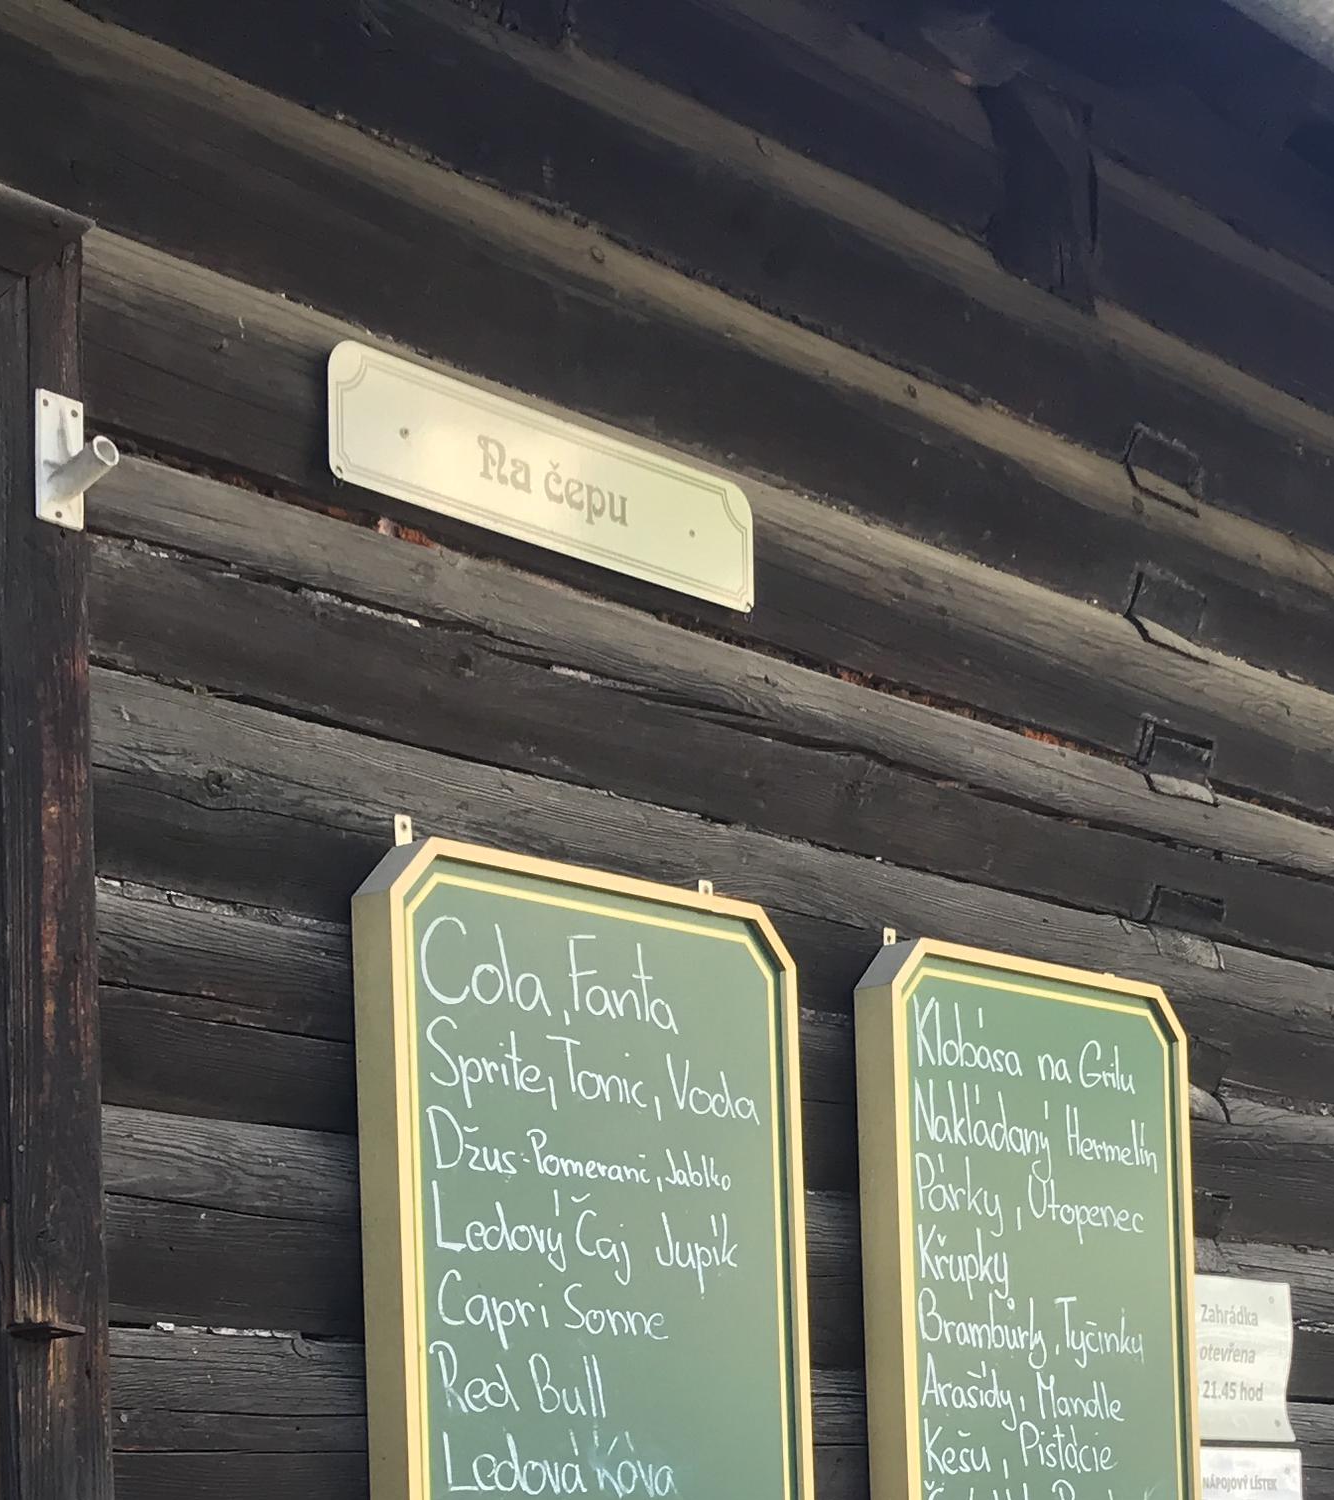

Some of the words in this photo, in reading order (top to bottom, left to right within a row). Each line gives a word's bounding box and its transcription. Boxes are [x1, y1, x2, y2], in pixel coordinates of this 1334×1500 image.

[477, 434, 533, 495] Na
[544, 459, 629, 527] čepu
[567, 934, 680, 1036] Fanta
[912, 993, 1023, 1078] Klobása
[1037, 1053, 1072, 1084] na
[1078, 1039, 1136, 1095] Grilu
[665, 1053, 761, 1126] Voda
[913, 1076, 1053, 1184] Nakládaný
[1066, 1103, 1159, 1174] Hermelín
[663, 1147, 733, 1193] Jablko
[432, 1180, 567, 1272] Ledový
[570, 1192, 632, 1285] Čaj
[655, 1211, 739, 1295] Jupík
[1027, 1173, 1145, 1245] Utopenec
[917, 1223, 1010, 1301] Křupky
[437, 1269, 549, 1350] Capri
[564, 1283, 670, 1340] Sonne
[1053, 1295, 1146, 1369] Tyčinky
[1199, 1303, 1260, 1327] Zahrádka
[428, 1340, 521, 1414] Red
[527, 1353, 607, 1419] Bull
[1198, 1342, 1257, 1365] otevřena
[1035, 1371, 1126, 1422] Mandle
[1239, 1381, 1265, 1402] hod
[441, 1428, 588, 1498] Ledová
[1018, 1420, 1120, 1474] Pistácie
[1249, 1474, 1278, 1492] LÍSTEK
